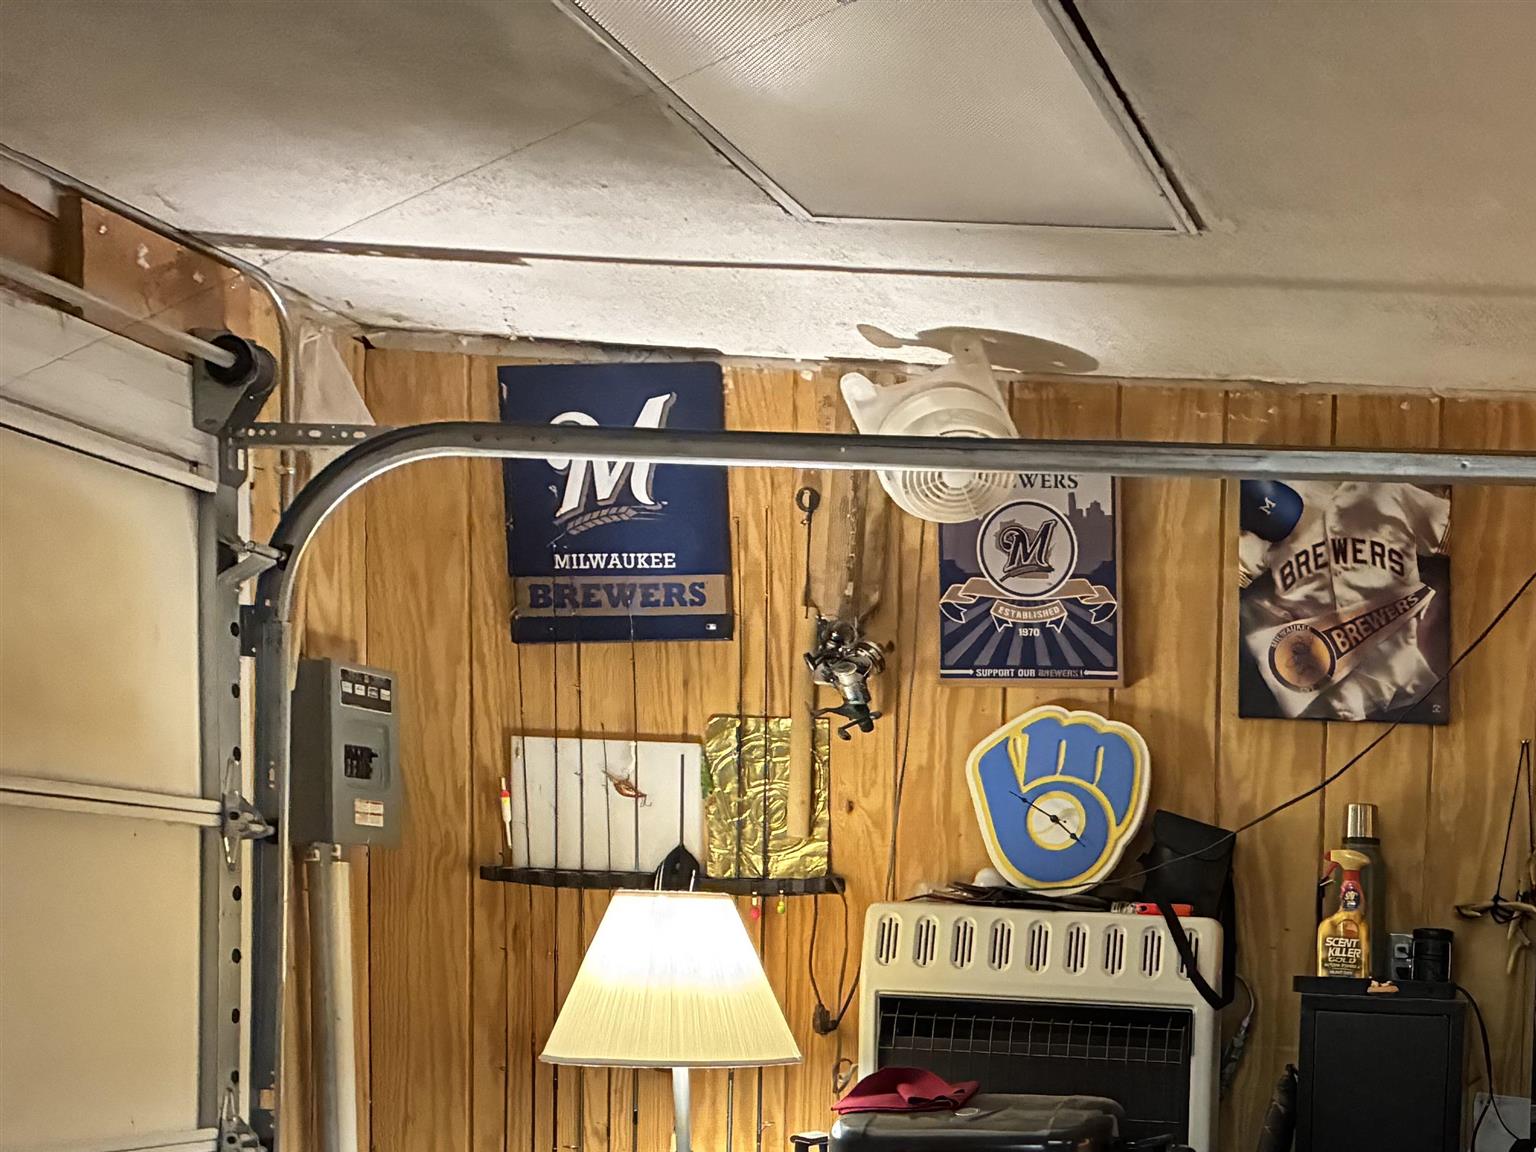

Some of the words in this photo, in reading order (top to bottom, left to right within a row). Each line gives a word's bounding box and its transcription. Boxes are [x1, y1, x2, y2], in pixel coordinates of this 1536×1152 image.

[1259, 496, 1277, 515] M
[554, 552, 677, 570] MILWAUKEE
[1279, 537, 1407, 591] BREWERS
[528, 582, 707, 610] BREWERS
[997, 605, 1061, 620] ESTABLISHED
[1331, 593, 1420, 653] BREWERS
[1018, 628, 1041, 638] 1970
[975, 668, 1015, 678] SUPPORT
[1017, 668, 1036, 678] OUR
[1325, 937, 1360, 948] SCENT
[1328, 946, 1361, 958] KILLER
